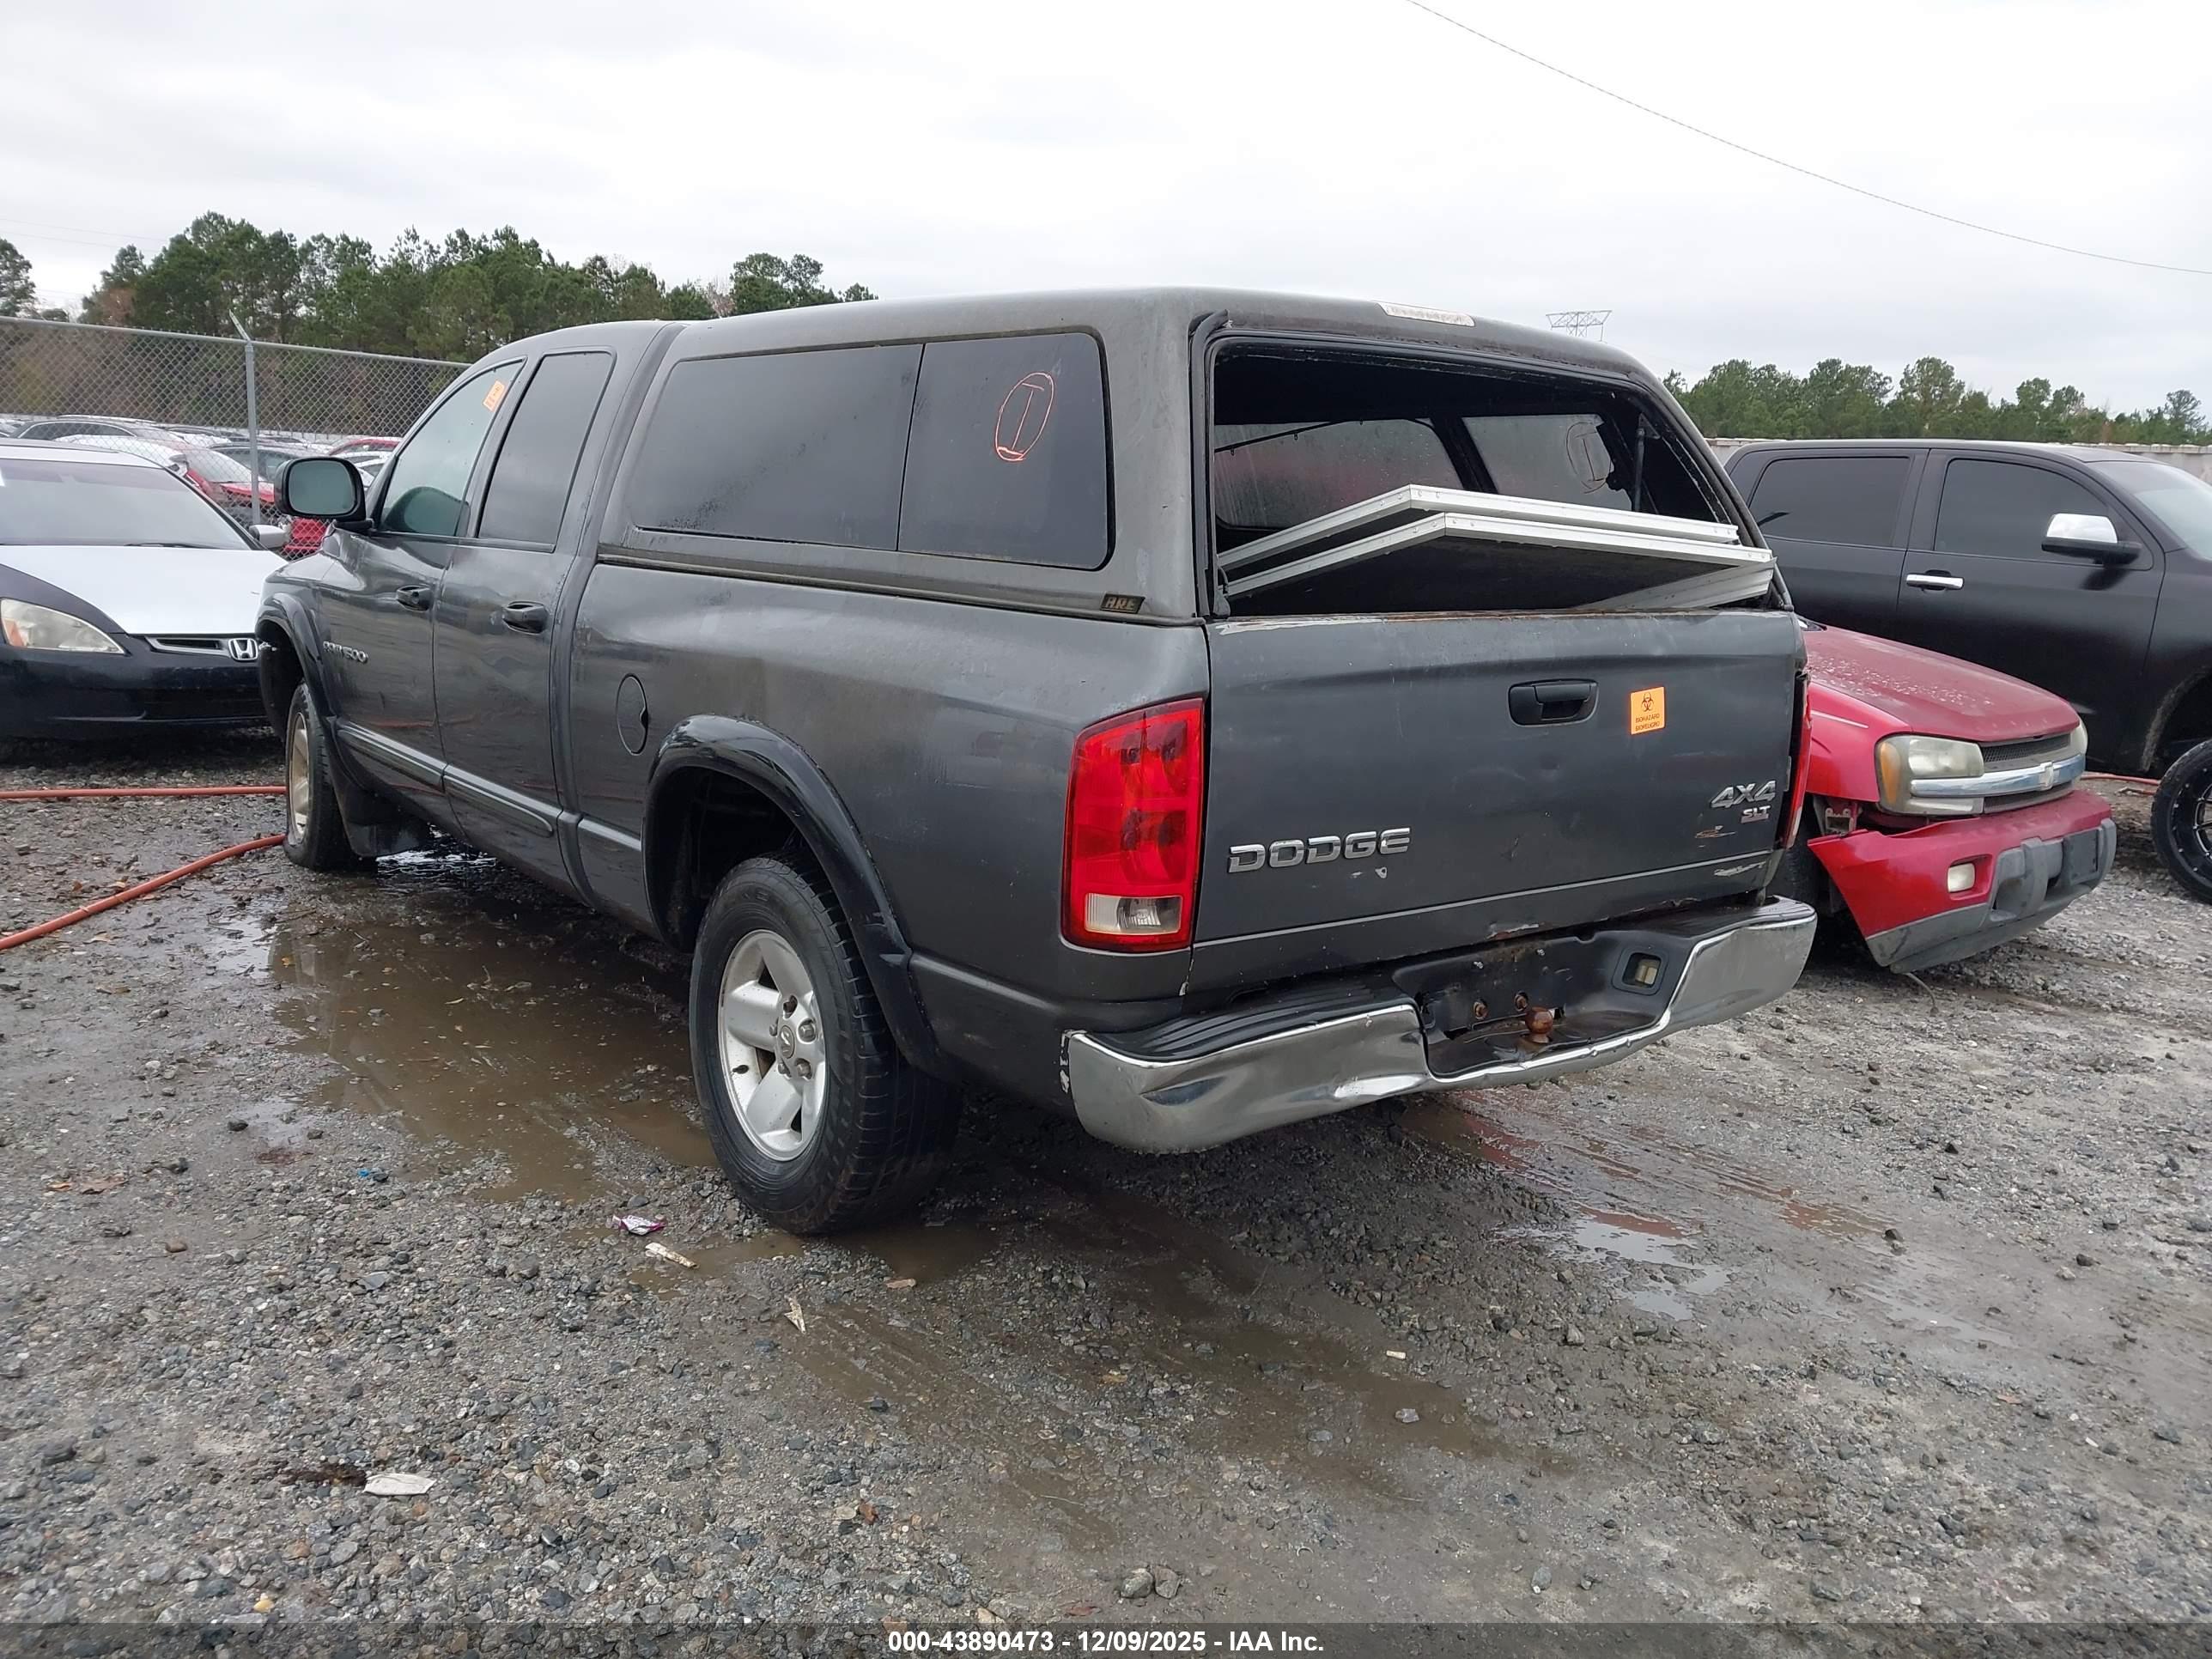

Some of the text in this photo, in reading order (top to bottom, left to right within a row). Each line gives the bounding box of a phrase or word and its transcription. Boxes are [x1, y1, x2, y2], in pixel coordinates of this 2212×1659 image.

[1635, 714, 1660, 723] BIOHAZARD
[1742, 805, 1771, 818] SLT
[1228, 827, 1411, 873] DODGE
